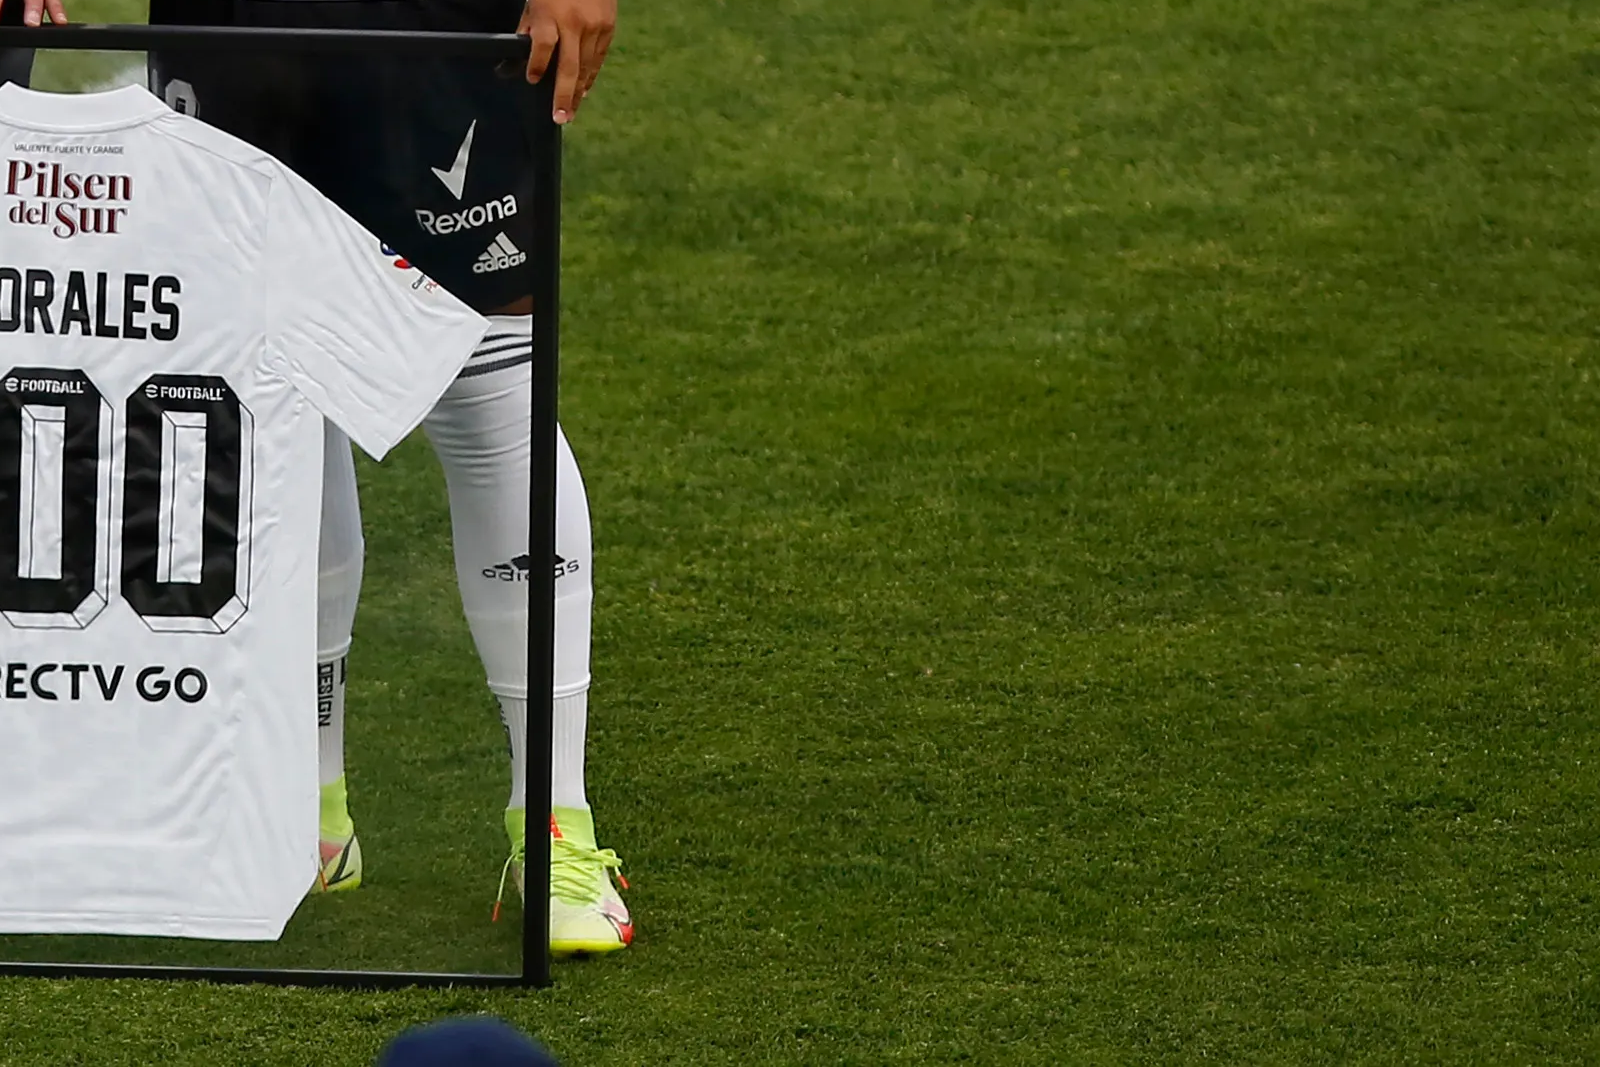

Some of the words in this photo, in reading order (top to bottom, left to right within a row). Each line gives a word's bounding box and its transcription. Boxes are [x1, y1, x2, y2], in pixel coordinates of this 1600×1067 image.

[4, 158, 133, 201] Pilsen
[8, 200, 50, 225] del
[52, 201, 129, 240] Sur
[415, 194, 518, 236] Rexona
[472, 251, 527, 274] adidas
[136, 665, 209, 703] GO
